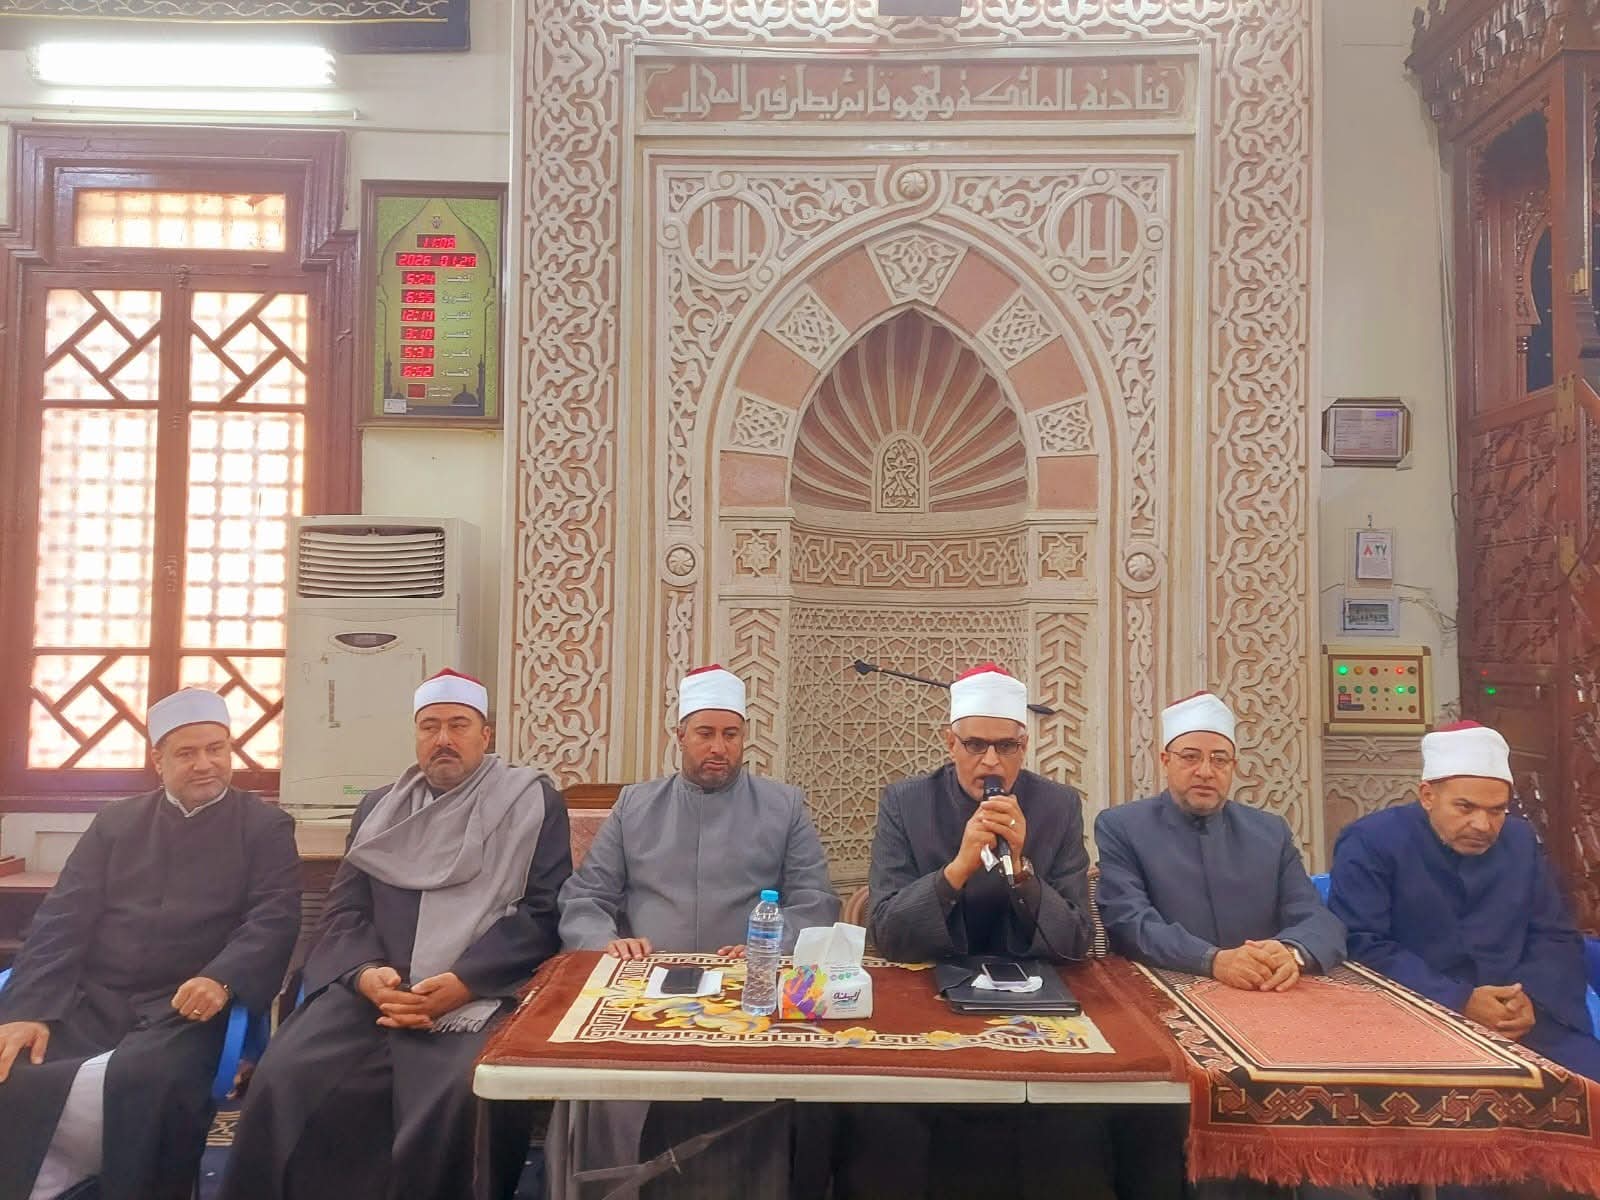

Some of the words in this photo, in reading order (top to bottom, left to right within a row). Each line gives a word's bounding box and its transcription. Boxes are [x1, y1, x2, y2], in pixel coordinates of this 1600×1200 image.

[398, 254, 432, 266] 2026
[405, 327, 433, 341] 3:10
[402, 364, 432, 378] 6:52
